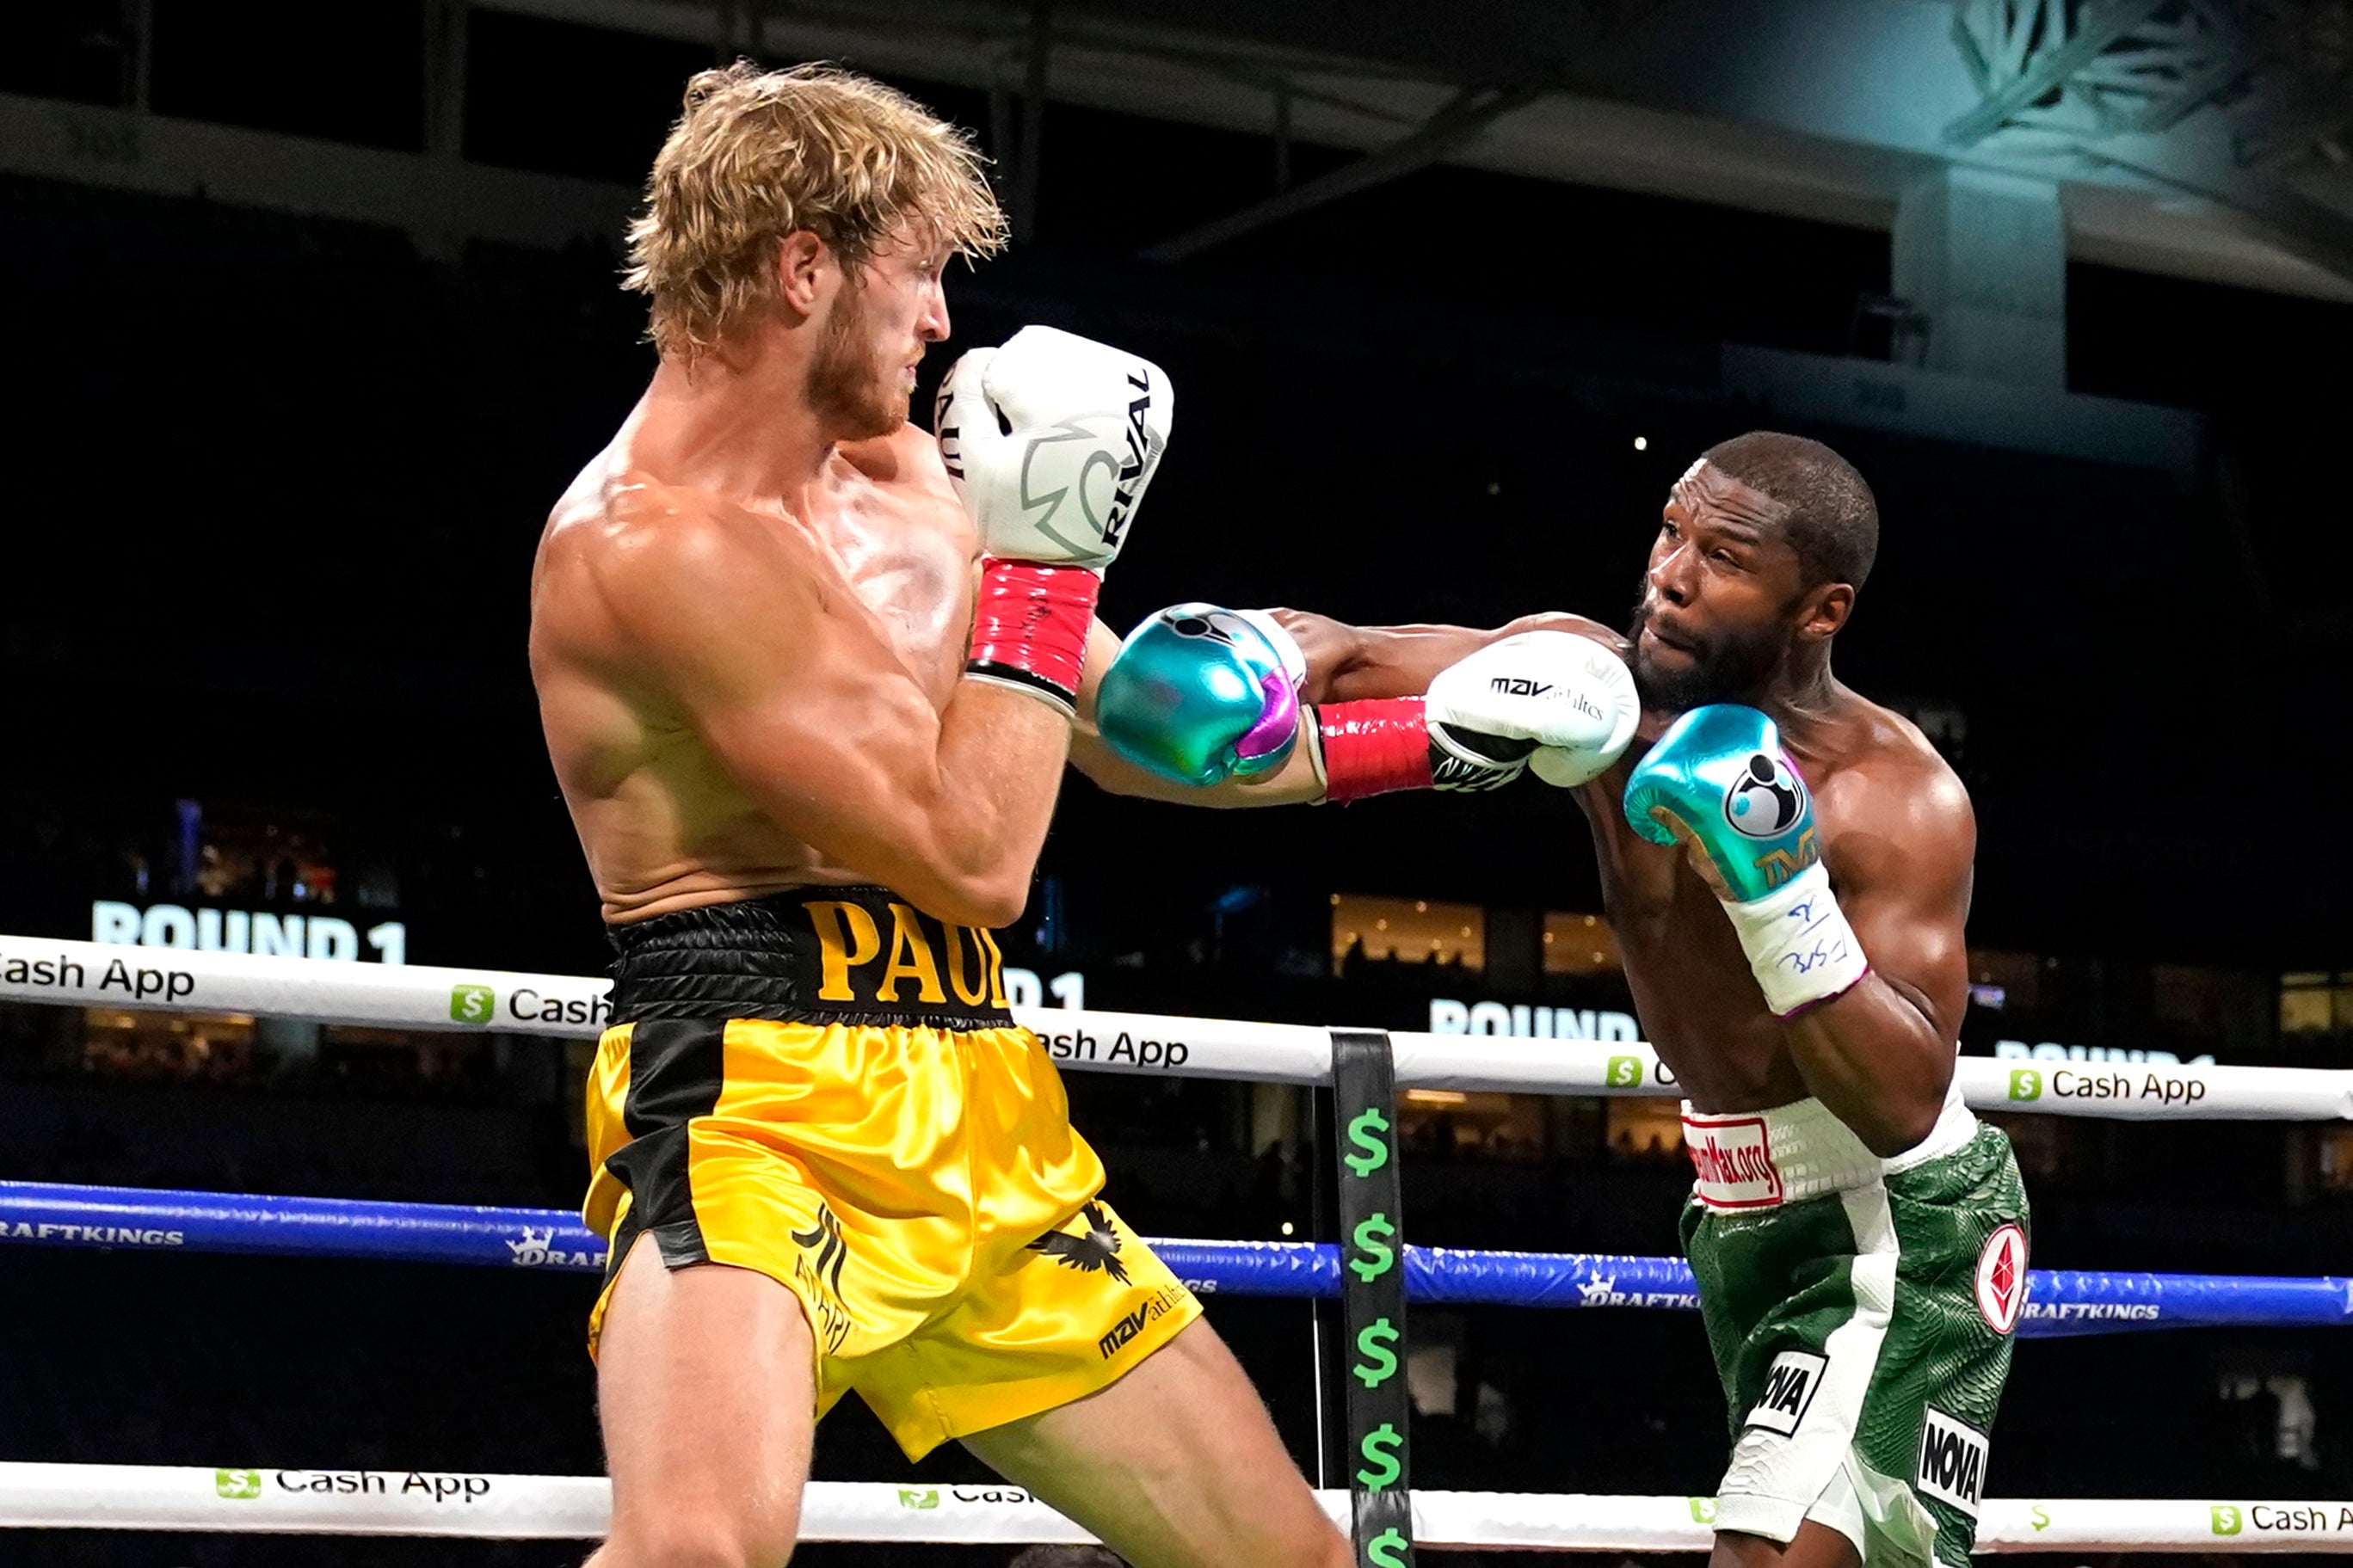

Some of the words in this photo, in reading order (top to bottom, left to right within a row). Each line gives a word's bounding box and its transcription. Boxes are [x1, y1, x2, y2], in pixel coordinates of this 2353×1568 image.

[1102, 368, 1150, 549] RIVAL
[92, 900, 359, 962] ROUND
[0, 954, 83, 987] ash
[99, 959, 194, 1001] App
[509, 988, 612, 1024] Cash
[1108, 1032, 1189, 1068] App
[2054, 1070, 2130, 1098] Cash
[2141, 1073, 2206, 1104] App
[796, 1253, 851, 1356] ATARI
[1580, 1291, 1701, 1307] DRAFTK
[2019, 1303, 2160, 1319] RAFTKINGS
[1759, 1365, 1810, 1417] OVA
[1922, 1423, 1980, 1505] NOVA
[276, 1470, 385, 1494] Cash
[401, 1472, 490, 1503] App
[2251, 1505, 2326, 1531] Cash
